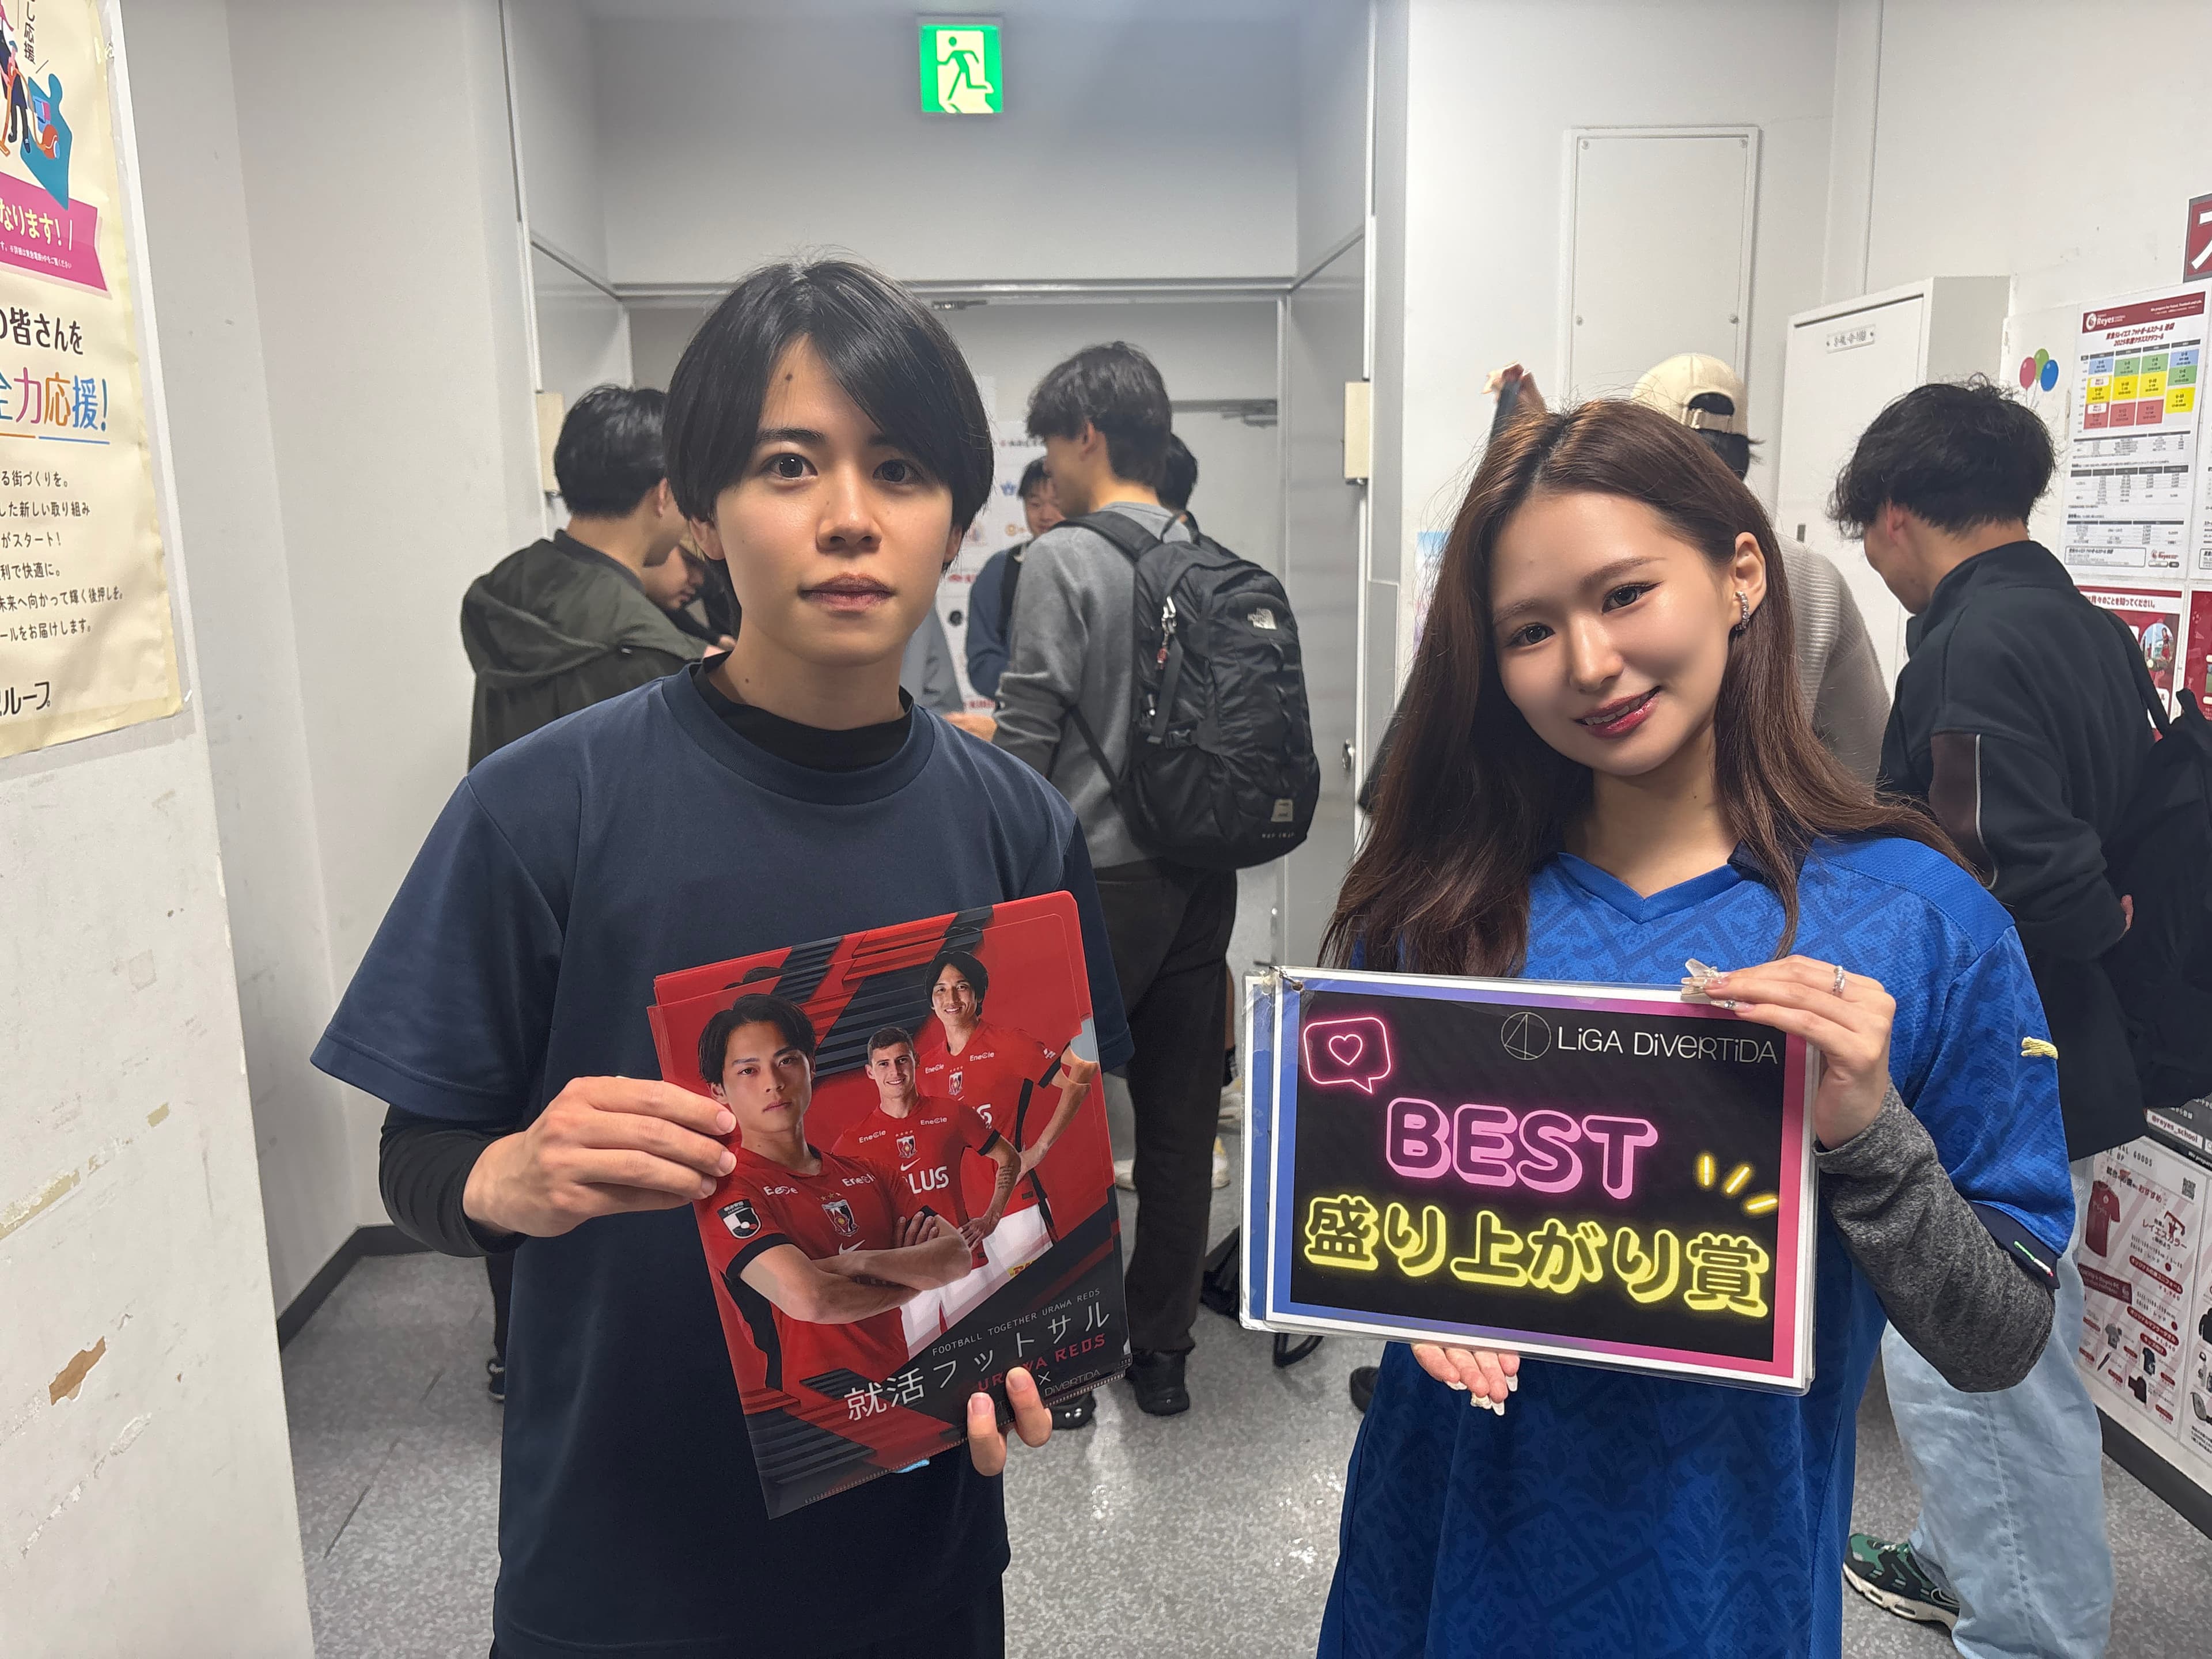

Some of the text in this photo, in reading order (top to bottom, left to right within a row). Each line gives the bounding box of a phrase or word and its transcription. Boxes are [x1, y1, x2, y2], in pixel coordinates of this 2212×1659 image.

[24, 0, 36, 65] し応援
[1, 470, 68, 487] る街づくりを。
[0, 562, 60, 581] 利で快適に。
[0, 681, 51, 716] ループ
[1385, 1097, 1658, 1200] BEST
[903, 1166, 949, 1194] LUS
[1305, 1194, 1769, 1317] 盛り上がり賞
[932, 1288, 1101, 1356] FOOTBALL TOGETHER URAWA REDS
[844, 1302, 1110, 1422] 就活フットサル
[978, 1333, 1107, 1392] URWA REDS
